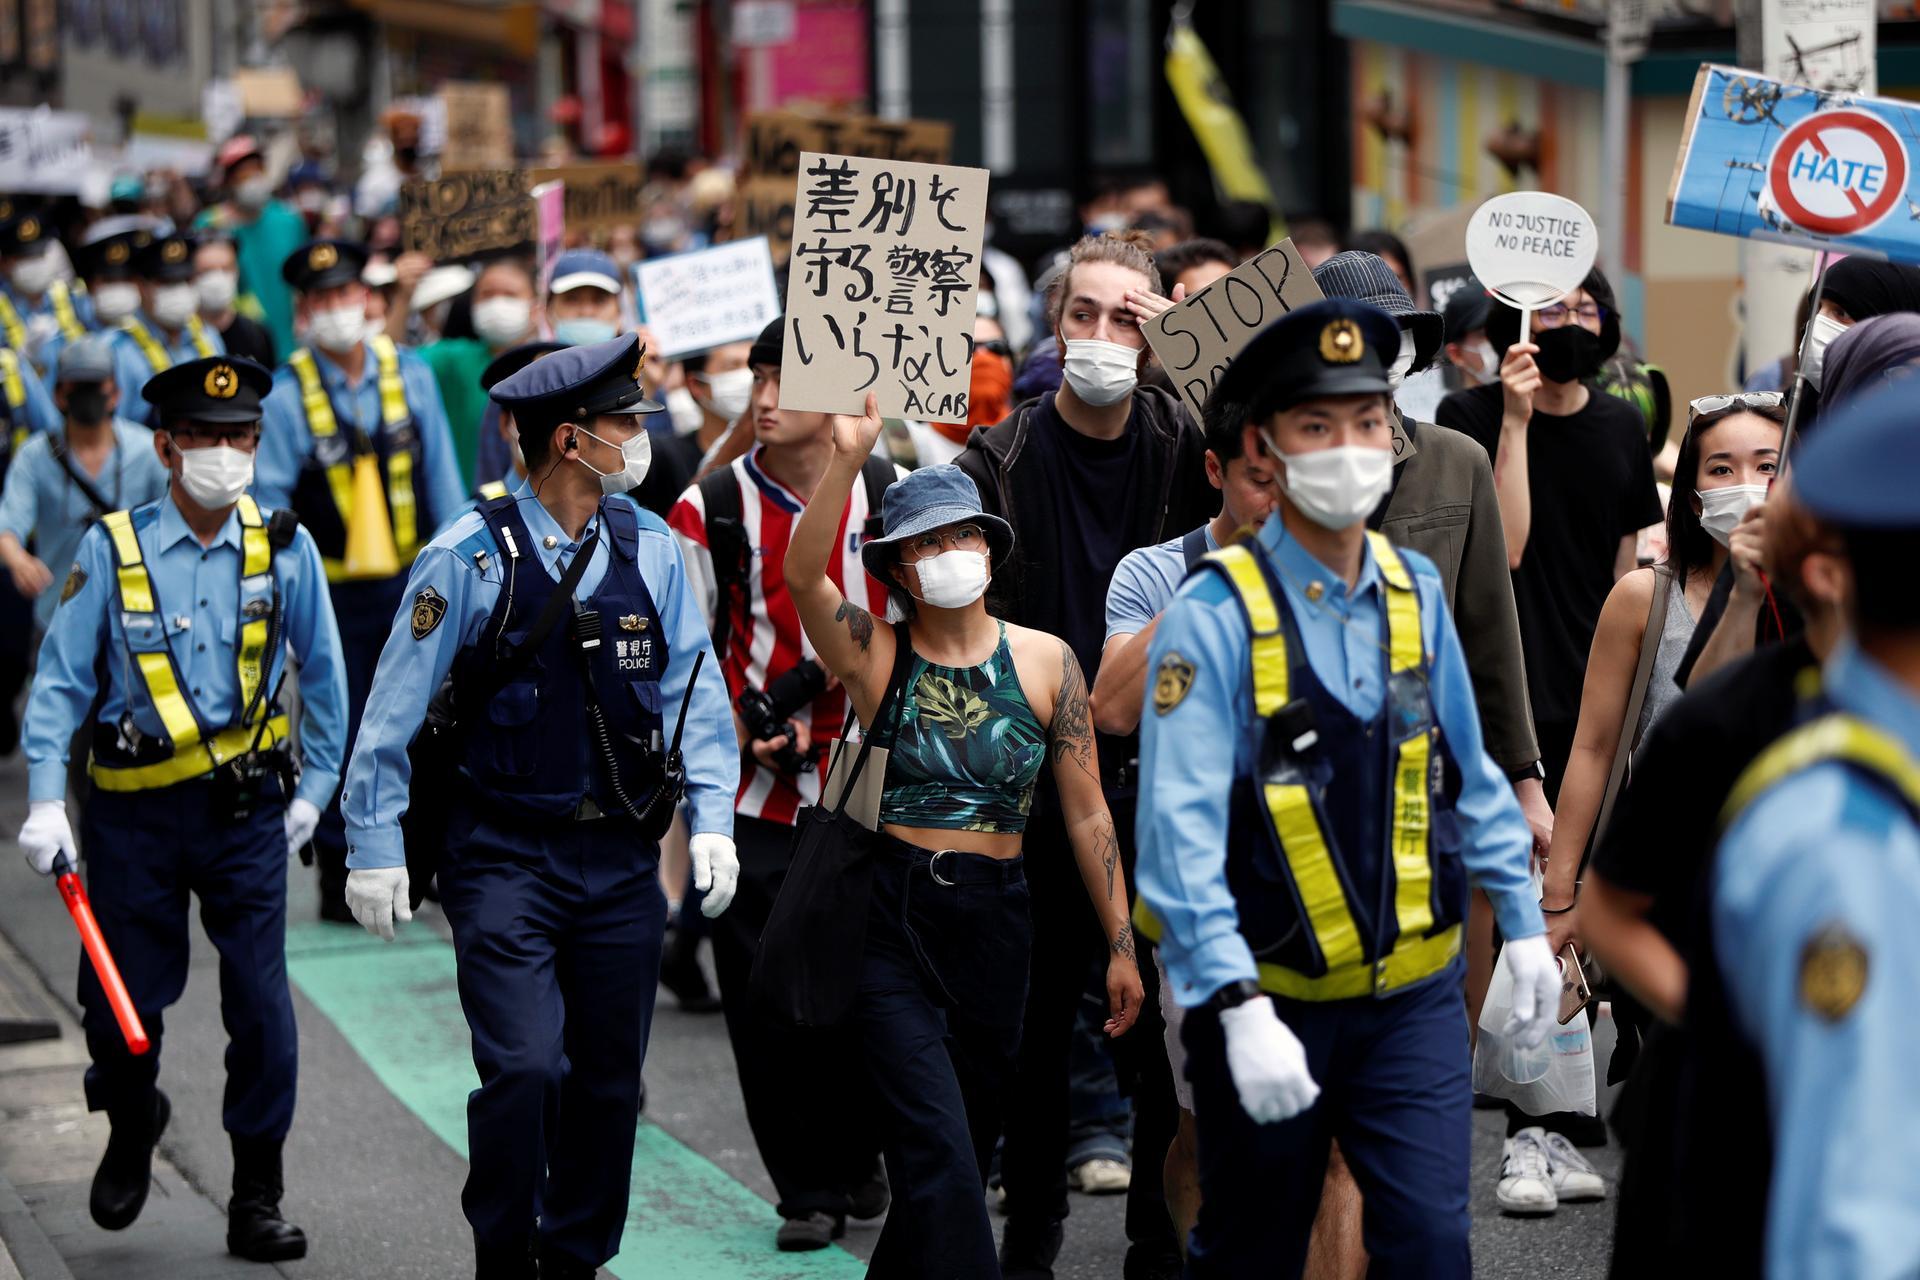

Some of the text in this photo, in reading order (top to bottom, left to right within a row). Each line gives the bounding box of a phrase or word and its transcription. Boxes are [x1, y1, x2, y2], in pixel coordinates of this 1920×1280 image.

[1792, 151, 1884, 193] HATE
[806, 157, 968, 236] 差別を
[1488, 211, 1581, 238] NO JUSTICE
[1495, 234, 1576, 258] NO PEACE
[1161, 248, 1291, 371] STOP
[793, 312, 974, 392] いらない
[899, 380, 968, 419] ACAB
[616, 639, 651, 657] 警視庁
[619, 658, 651, 670] POLICE
